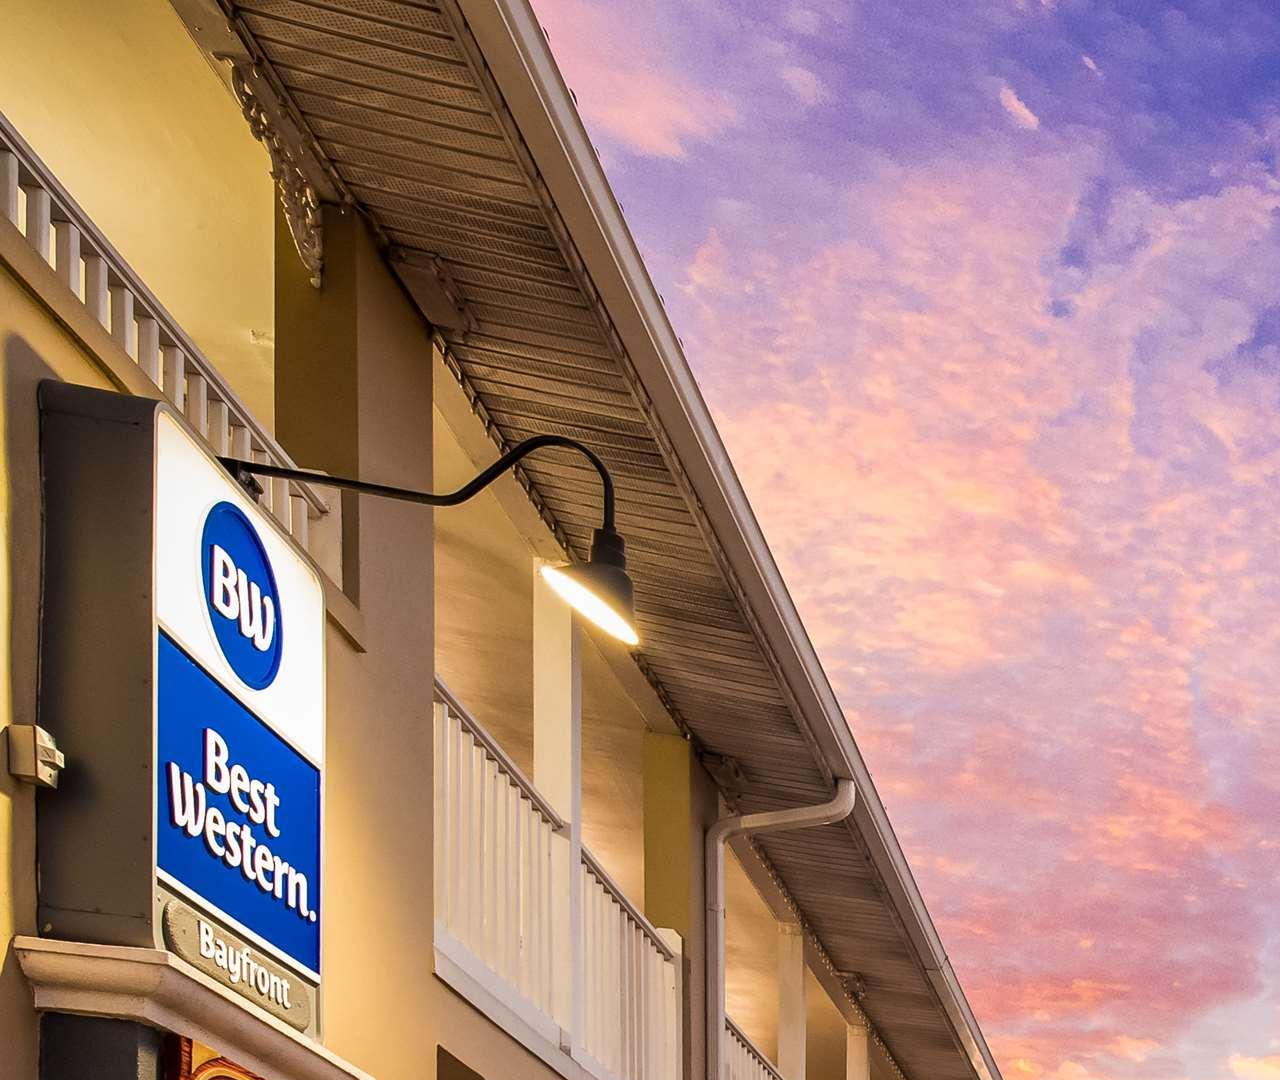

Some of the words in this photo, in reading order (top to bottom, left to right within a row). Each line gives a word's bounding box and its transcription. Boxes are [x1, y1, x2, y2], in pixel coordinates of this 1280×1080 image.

[211, 544, 275, 652] BW
[204, 728, 280, 838] Best
[198, 920, 291, 1009] Bayfront
